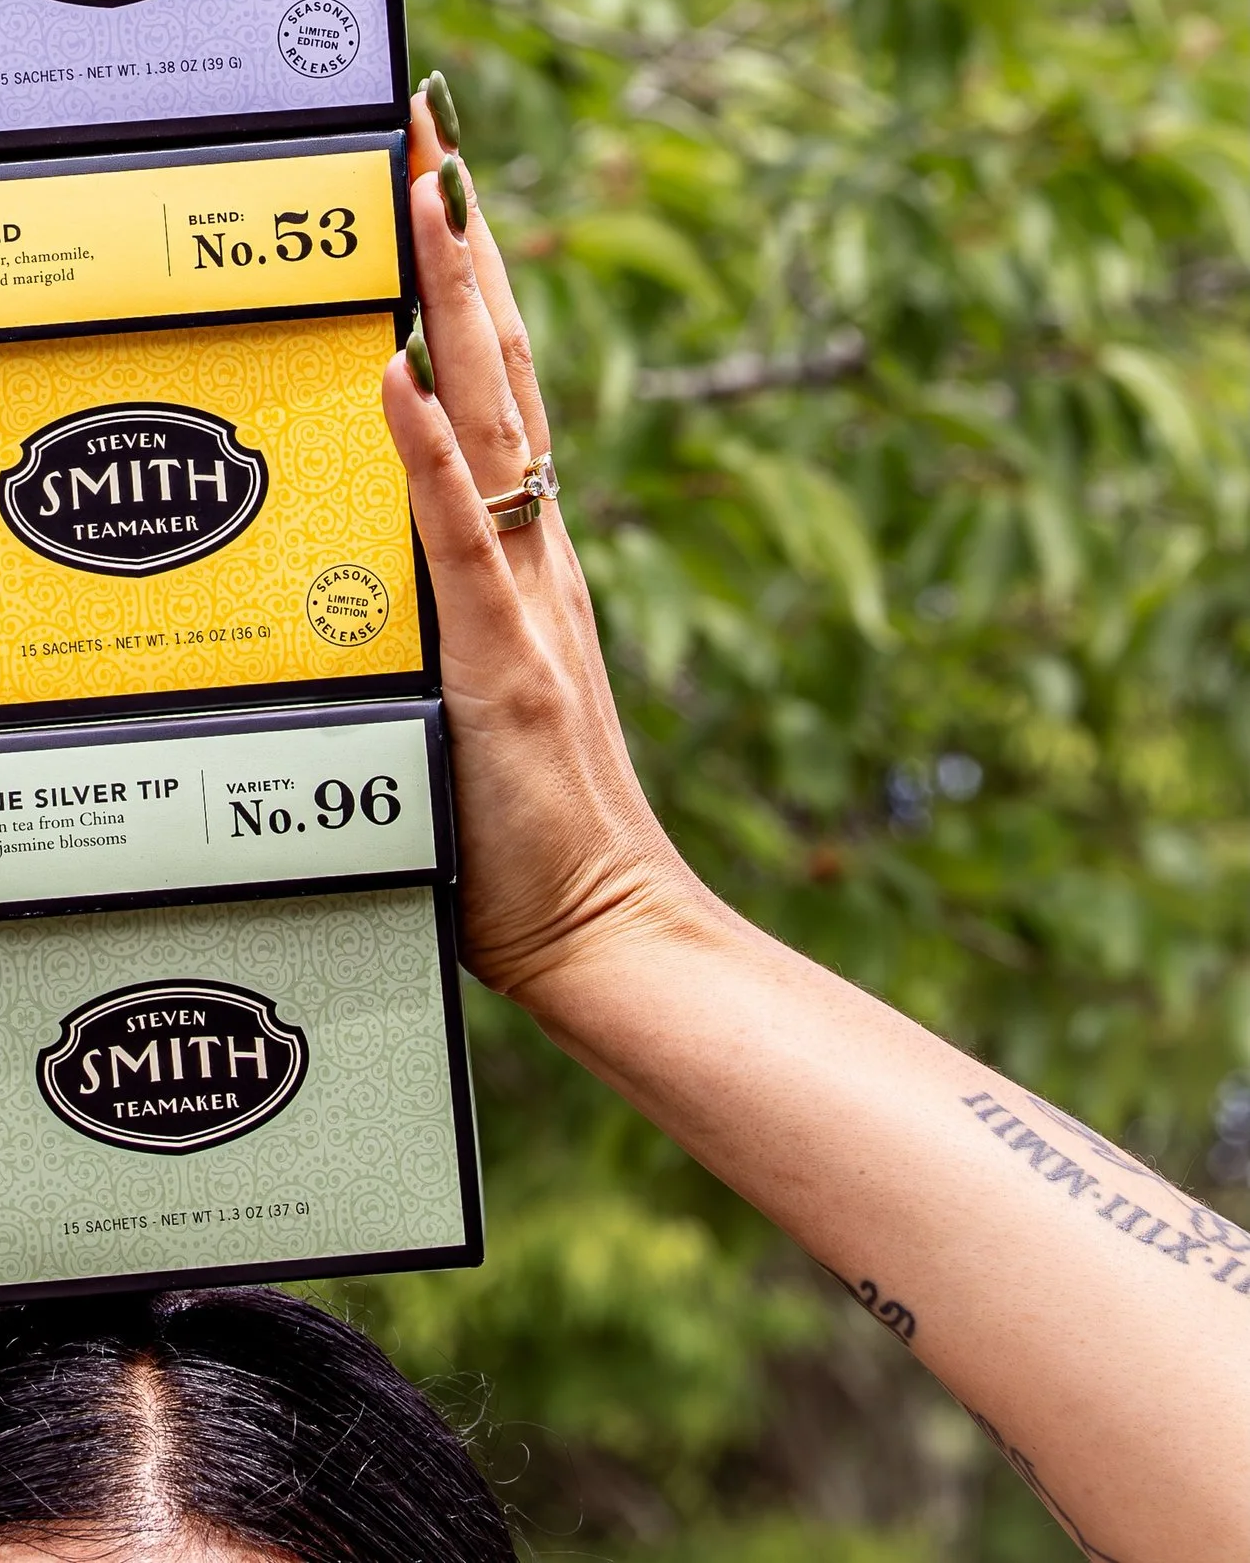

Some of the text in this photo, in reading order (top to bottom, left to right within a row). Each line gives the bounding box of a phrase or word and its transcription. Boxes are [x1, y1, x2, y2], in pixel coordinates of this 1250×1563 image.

[288, 2, 354, 33] SEASONAL
[300, 26, 339, 38] LIMITED
[298, 37, 338, 50] EDITION
[15, 69, 74, 84] SACHETS
[88, 66, 112, 78] NET
[117, 63, 140, 77] WT.
[146, 61, 175, 74] 1.38
[181, 60, 197, 72] OZ
[203, 58, 223, 71] (39
[229, 57, 241, 69] G)
[286, 48, 346, 73] RELEASE
[189, 212, 244, 225] BLEND:
[15, 247, 94, 264] chamomile,
[13, 268, 74, 286] marigold
[88, 433, 165, 454] STEVEN
[40, 459, 227, 515] SMITH
[73, 516, 198, 540] TEAMAKER
[316, 570, 382, 601] SEASONAL
[327, 605, 367, 618] EDITION
[328, 595, 368, 606] LIMITED
[315, 616, 376, 642] RELEASE
[22, 644, 37, 657] 15
[43, 639, 102, 655] SACHETS
[116, 636, 141, 649] NET
[146, 634, 169, 648] WT.
[175, 631, 204, 644] 1.26
[209, 629, 226, 641] OZ
[232, 627, 252, 641] (36
[258, 626, 270, 638] G)
[35, 783, 127, 808] SILVER
[137, 779, 178, 799] TIP
[227, 779, 294, 794] VARIETY:
[13, 822, 33, 831] tea
[40, 816, 74, 829] from
[80, 812, 124, 825] China
[59, 830, 127, 849] blossoms
[127, 1011, 205, 1032] STEVEN
[80, 1036, 267, 1094] SMITH
[114, 1093, 239, 1118] TEAMAKER
[64, 1222, 79, 1235] 15
[86, 1216, 147, 1233] SACHETS
[162, 1213, 187, 1226] NET
[192, 1210, 212, 1223] WT
[219, 1208, 239, 1221] 1.3
[246, 1206, 263, 1219] OZ
[269, 1204, 289, 1218] (37
[296, 1202, 309, 1215] G)
